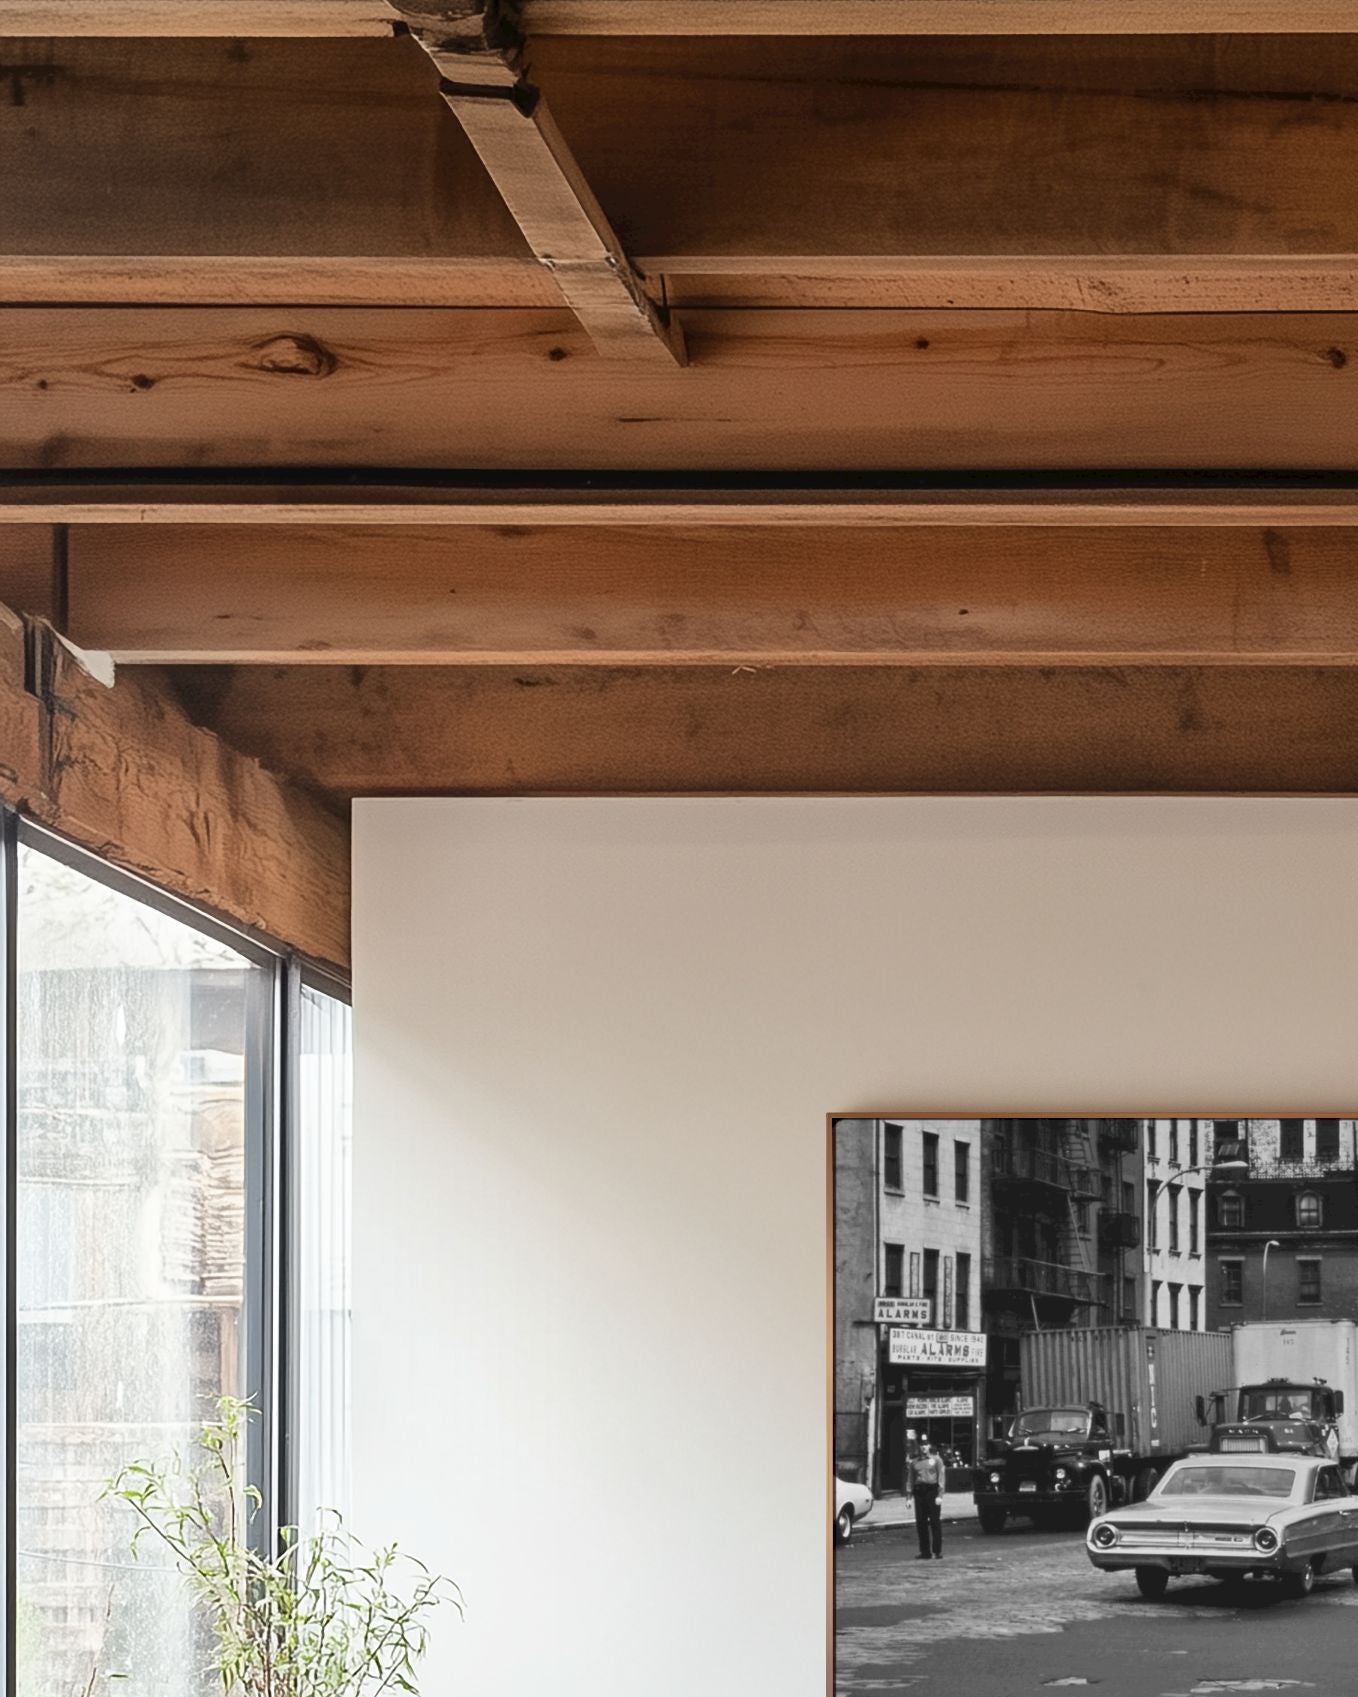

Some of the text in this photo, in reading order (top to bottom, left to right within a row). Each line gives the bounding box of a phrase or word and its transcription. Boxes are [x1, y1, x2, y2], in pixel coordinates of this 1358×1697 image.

[878, 1309, 927, 1319] ALARMS
[906, 1331, 925, 1340] CANAL
[950, 1334, 968, 1342] SINCE
[921, 1342, 970, 1357] ALARMS
